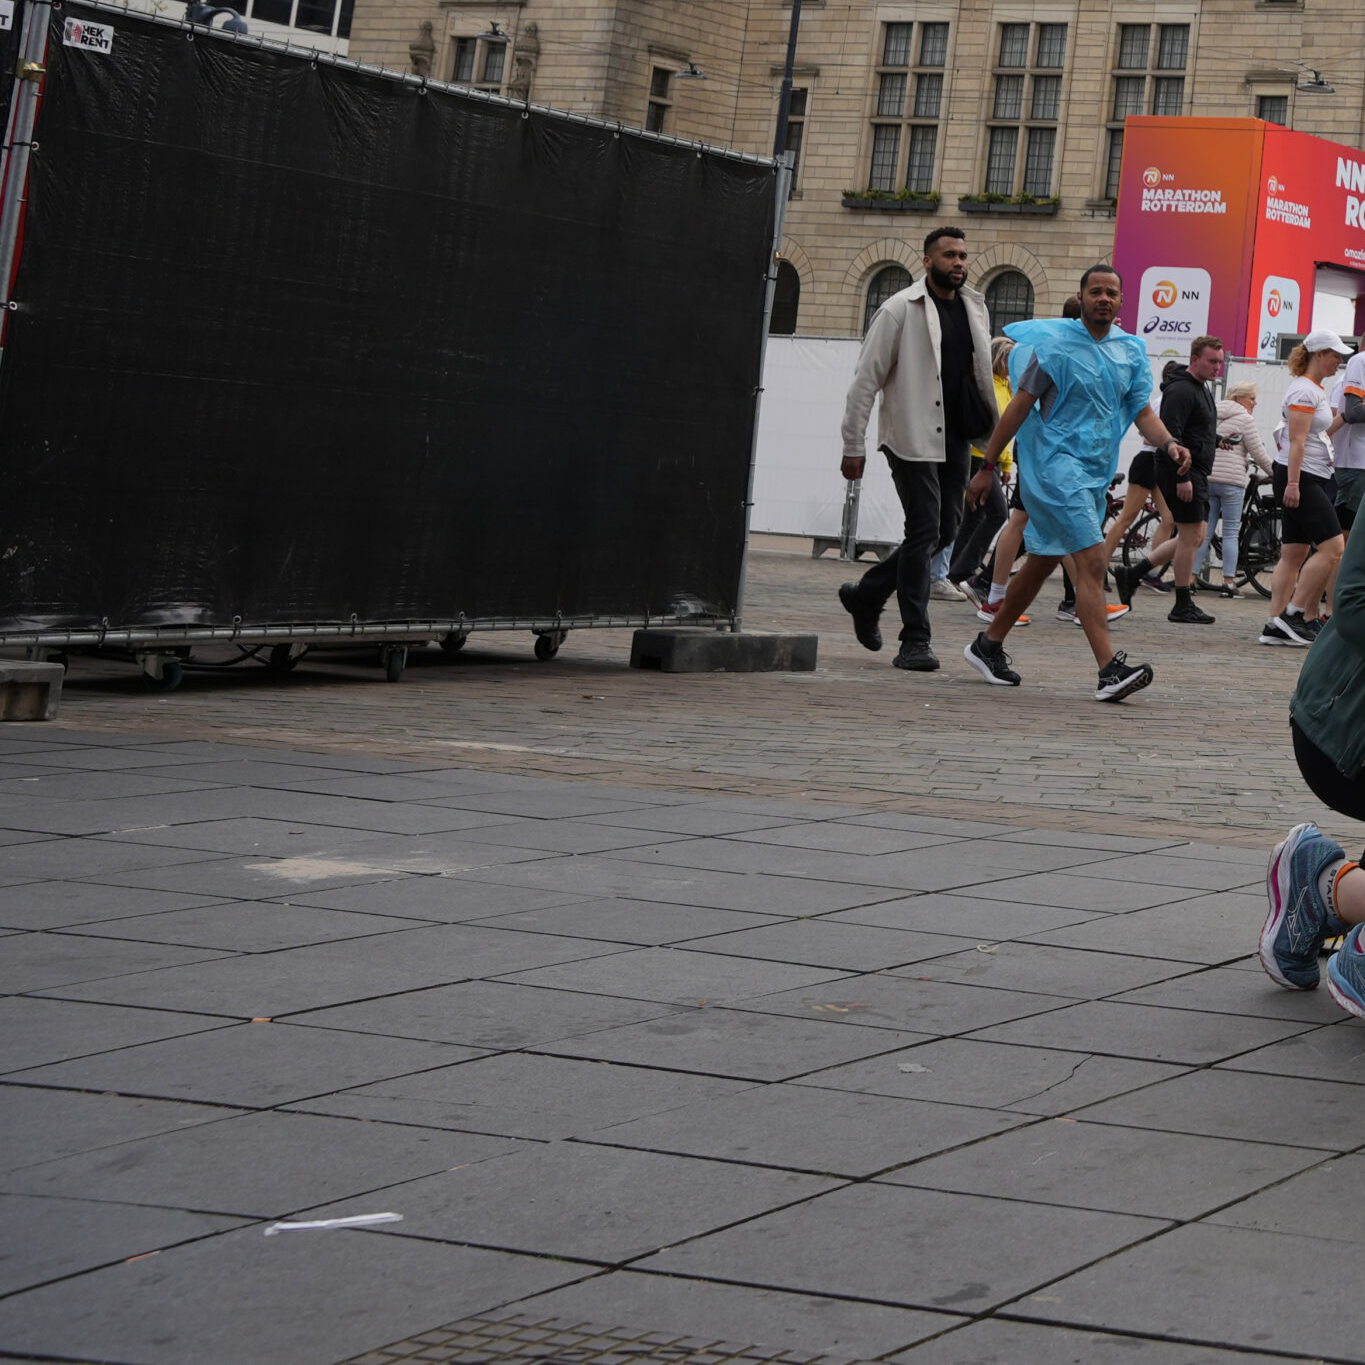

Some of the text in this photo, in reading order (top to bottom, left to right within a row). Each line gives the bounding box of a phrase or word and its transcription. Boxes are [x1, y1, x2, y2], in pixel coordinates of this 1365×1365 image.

[82, 25, 104, 38] HEK
[80, 35, 110, 49] RENT
[1162, 173, 1175, 181] NN
[1142, 189, 1222, 202] MARATHON
[1141, 200, 1227, 213] ROTTERDAM
[1267, 196, 1309, 217] MARATHON
[1266, 207, 1311, 230] ROTTERDAM
[1182, 291, 1200, 300] NN
[1283, 300, 1293, 311] NN
